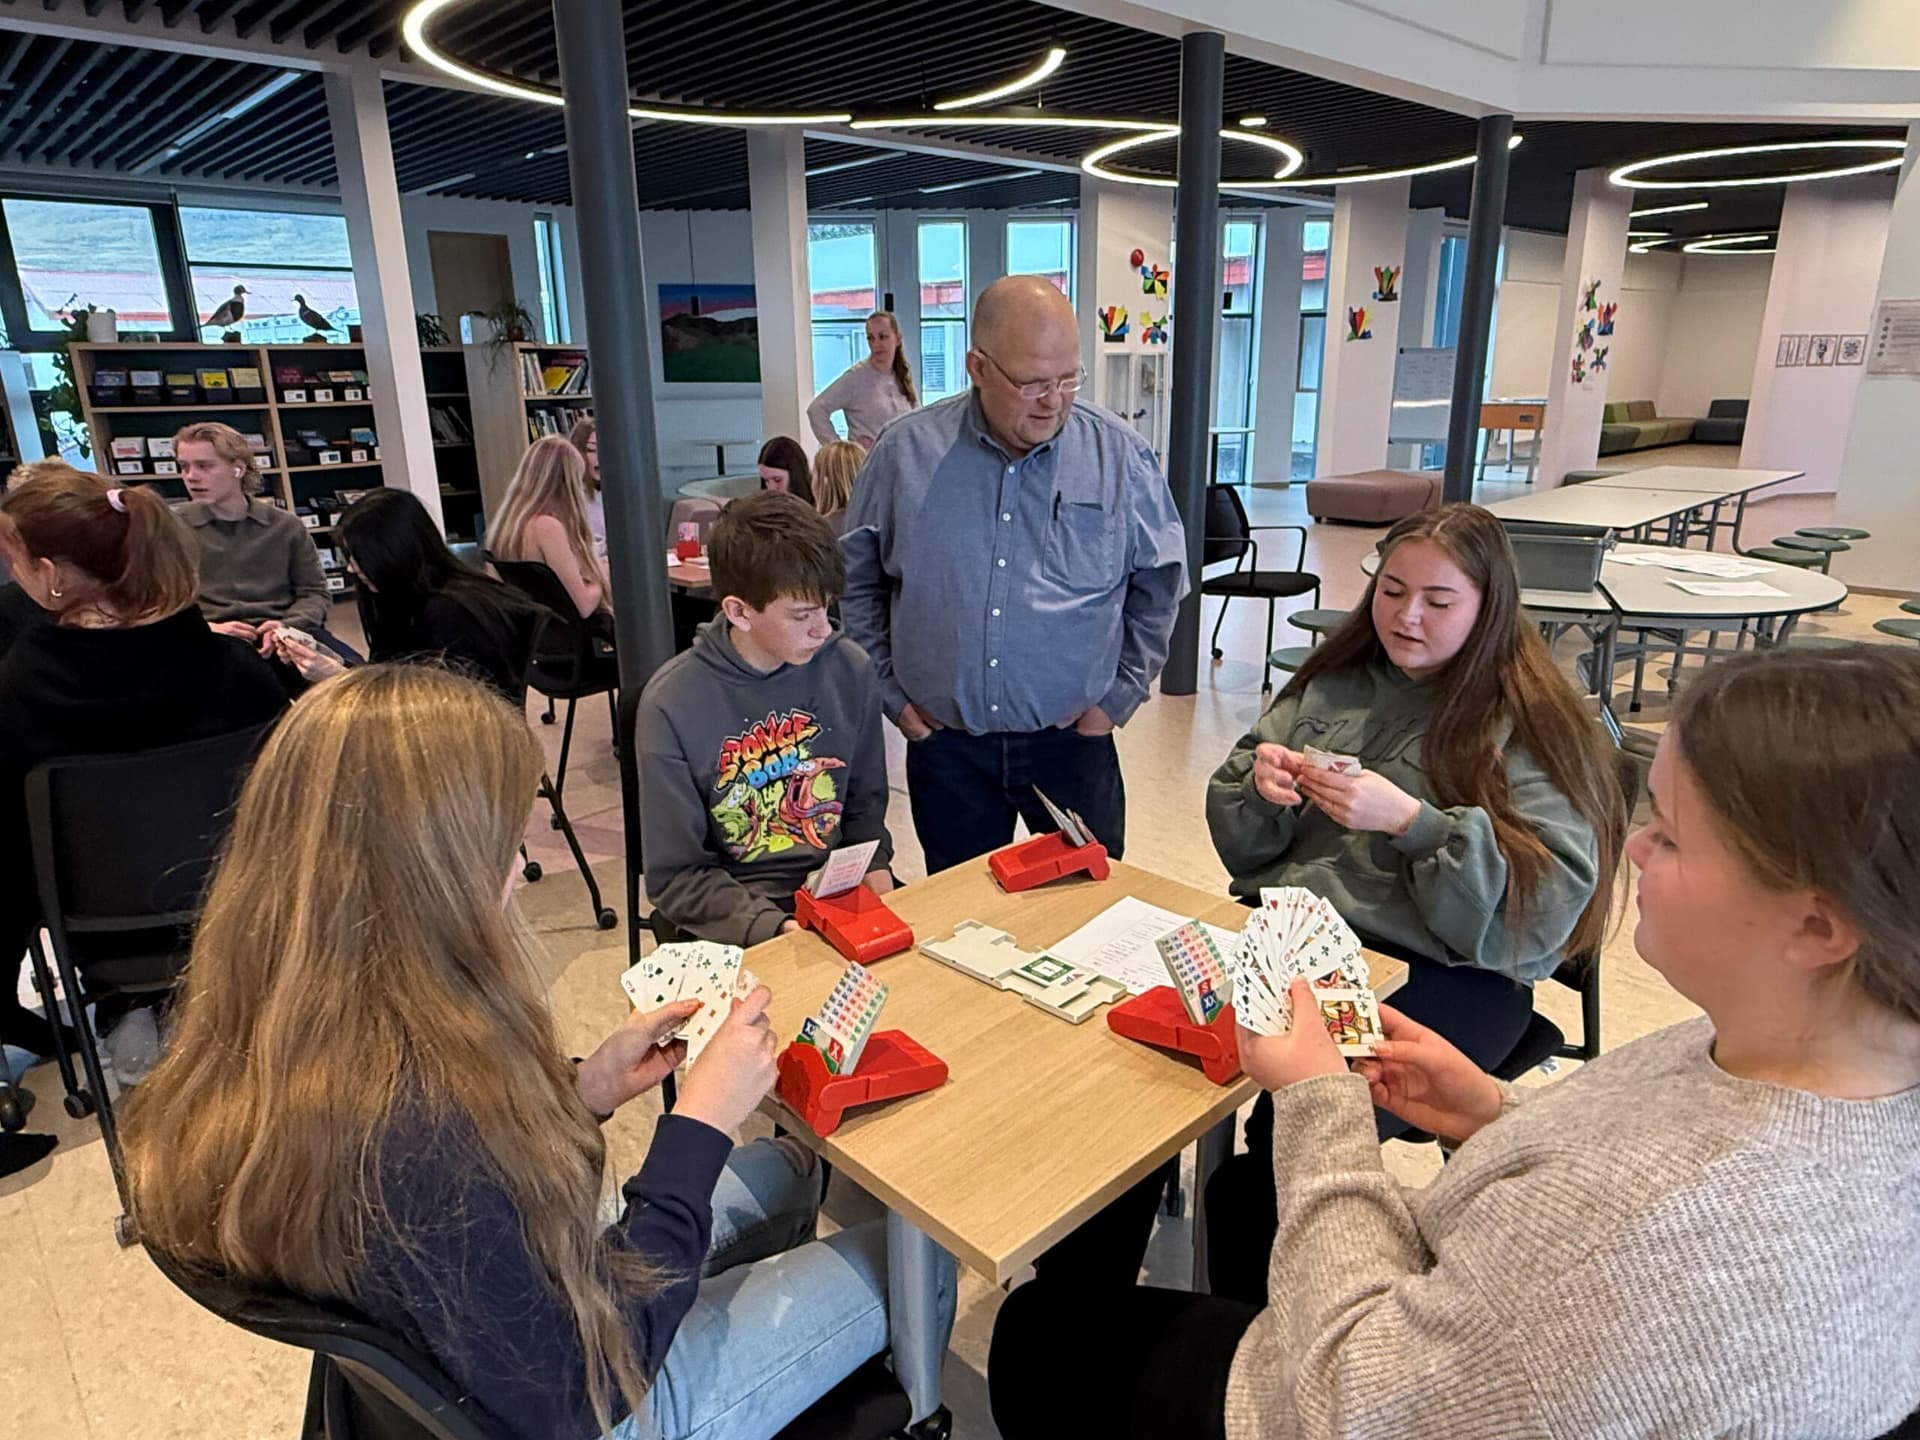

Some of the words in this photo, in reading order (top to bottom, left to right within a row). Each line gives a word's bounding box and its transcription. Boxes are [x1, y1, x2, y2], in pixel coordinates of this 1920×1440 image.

[715, 711, 820, 789] SPONGE
[742, 744, 800, 788] BOB
[830, 1042, 841, 1060] X
